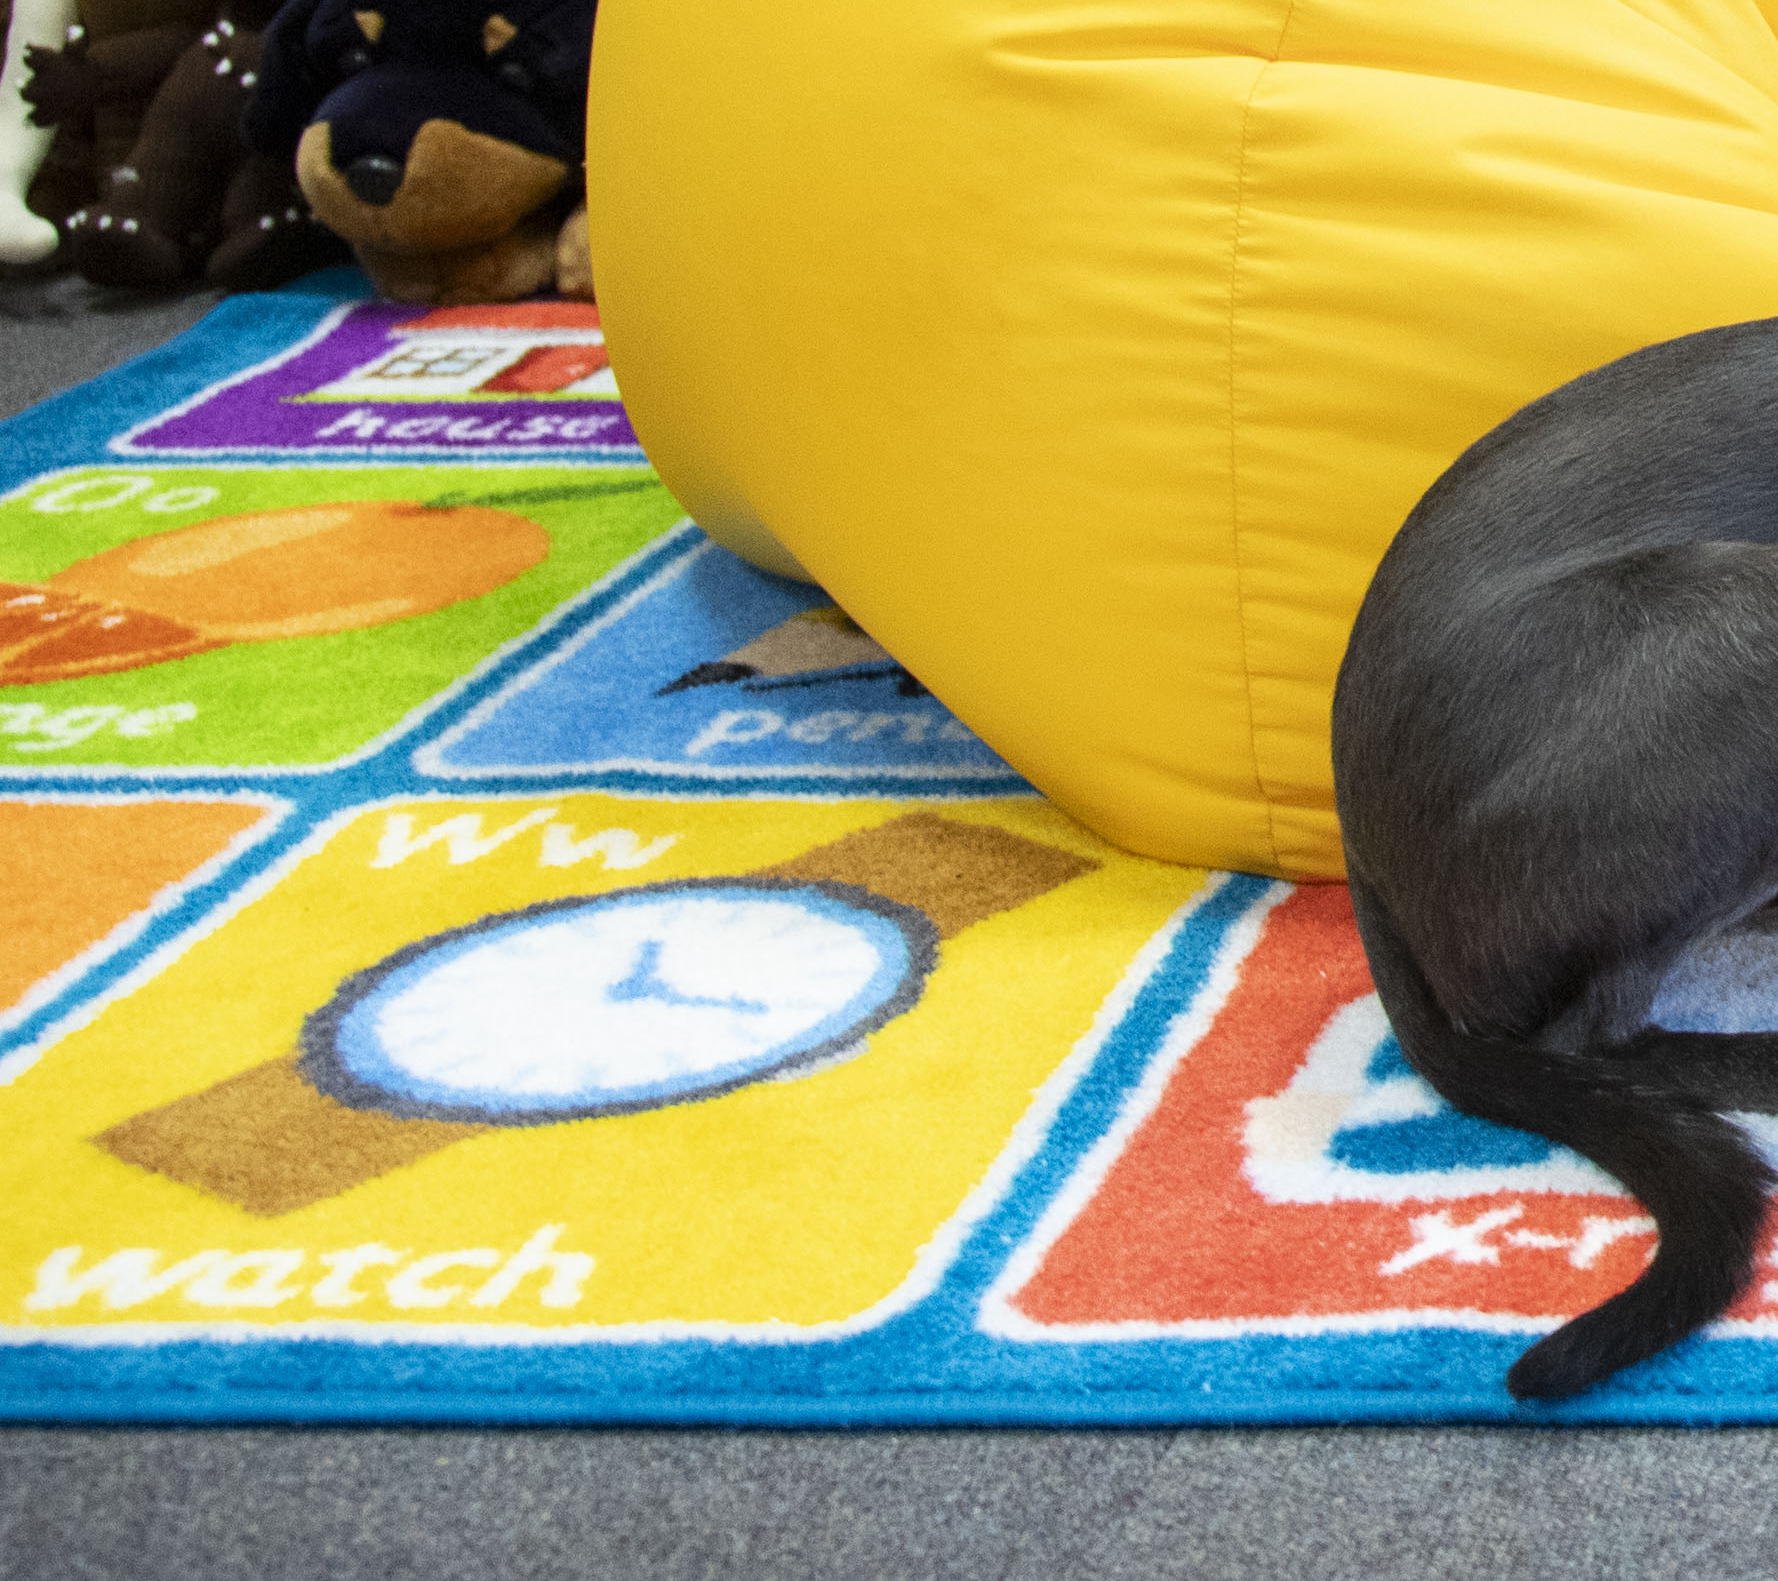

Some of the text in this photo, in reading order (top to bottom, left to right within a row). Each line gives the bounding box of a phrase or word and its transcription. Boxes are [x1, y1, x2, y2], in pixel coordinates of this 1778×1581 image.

[316, 401, 620, 444] house
[29, 474, 220, 516] Oo
[367, 806, 684, 872] Ww
[22, 1223, 596, 1313] watch
